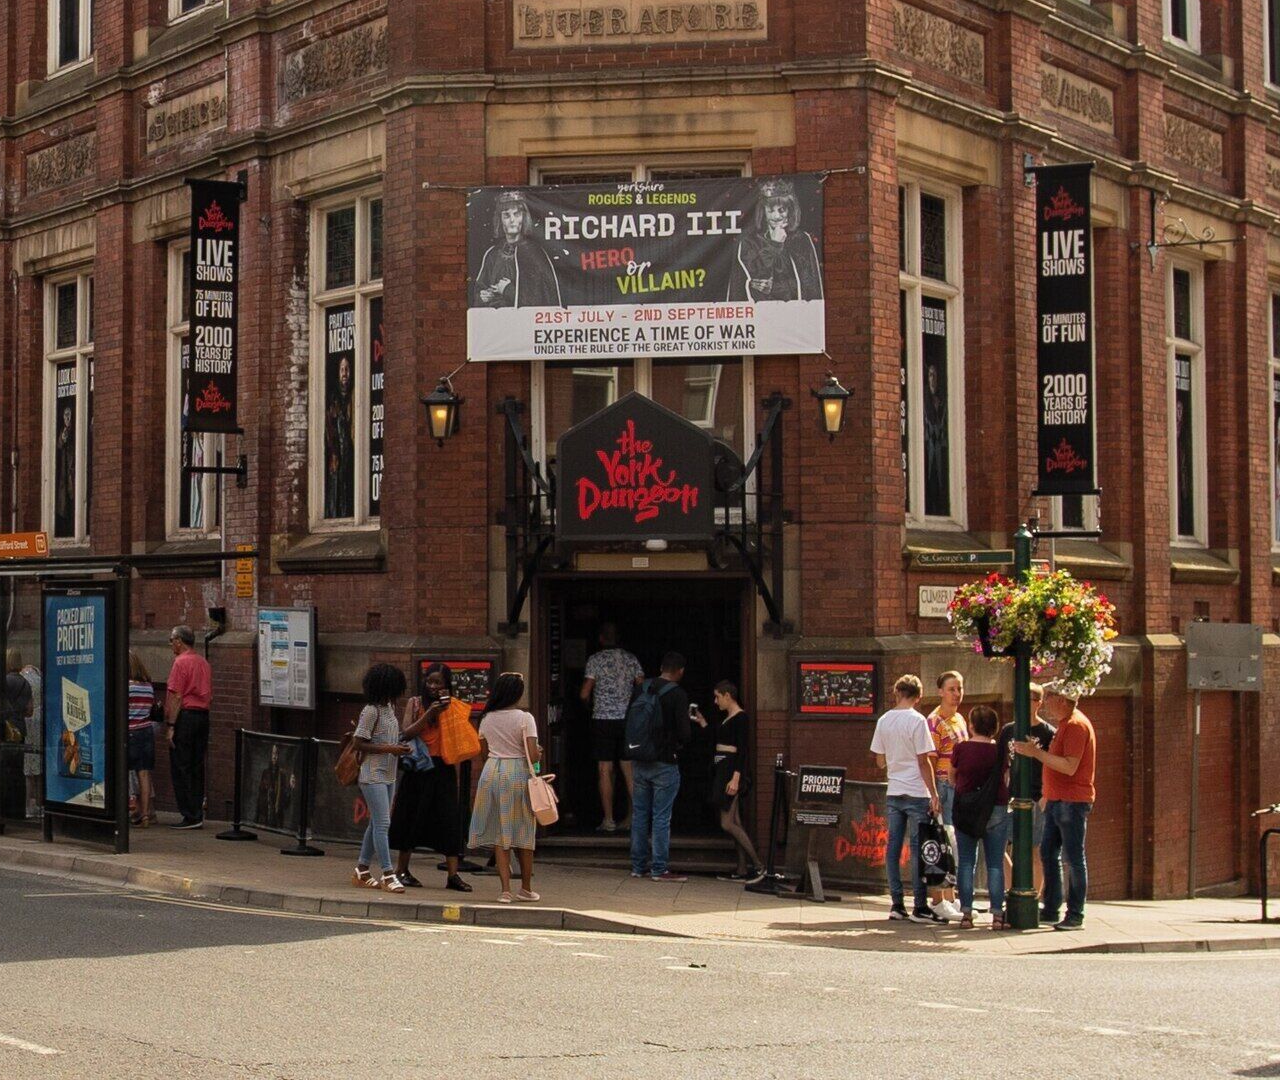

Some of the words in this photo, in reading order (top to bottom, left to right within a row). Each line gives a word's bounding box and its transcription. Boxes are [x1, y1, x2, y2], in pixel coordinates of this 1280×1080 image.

[588, 194, 633, 205] ROGUES
[635, 194, 643, 205] &
[646, 193, 697, 205] LEGENDS
[545, 213, 675, 240] RICHARD
[687, 210, 742, 236] III
[197, 238, 233, 267] LIVE
[1042, 229, 1084, 260] LIVE
[581, 247, 635, 271] HERO
[626, 260, 651, 276] or
[1042, 259, 1085, 277] SHOWS
[196, 266, 233, 283] SHOWS
[616, 269, 706, 295] VILLAIN?
[195, 290, 204, 301] 75
[205, 291, 233, 303] MINUTES
[195, 300, 210, 317] OF
[211, 301, 233, 319] FUN
[535, 312, 571, 324] 21ST
[578, 311, 615, 322] JULY
[634, 309, 662, 321] 2ND
[667, 307, 754, 321] SEPTEMBER
[1042, 313, 1051, 325] 75
[1052, 312, 1086, 325] MINUTES
[195, 325, 232, 348] 2000
[534, 327, 630, 344] EXPERIENCE
[635, 327, 646, 341] A
[650, 326, 689, 341] TIME
[694, 325, 715, 340] OF
[719, 324, 755, 339] WAR
[1043, 325, 1060, 343] OF
[1061, 323, 1085, 342] FUN
[195, 347, 221, 361] YEARS
[222, 347, 232, 361] OF
[534, 345, 566, 355] UNDER
[568, 344, 587, 354] THE
[590, 344, 614, 353] RULE
[617, 343, 630, 353] OF
[632, 342, 651, 352] THE
[653, 341, 684, 352] GREAT
[687, 340, 729, 351] YORKIST
[732, 340, 756, 351] KING
[195, 359, 232, 374] HISTORY
[1044, 373, 1086, 397] 2000
[1044, 396, 1074, 411] YEARS
[1075, 395, 1087, 410] OF
[372, 405, 384, 420] 200
[1044, 409, 1087, 426] HISTORY
[616, 419, 653, 456] the
[596, 450, 676, 487] York
[576, 477, 699, 523] Dungeon
[57, 607, 79, 625] PACKED
[79, 605, 94, 623] WITH
[57, 623, 94, 651] PROTEIN
[801, 784, 841, 794] ENTRANCE
[802, 774, 842, 786] PRIORITY
